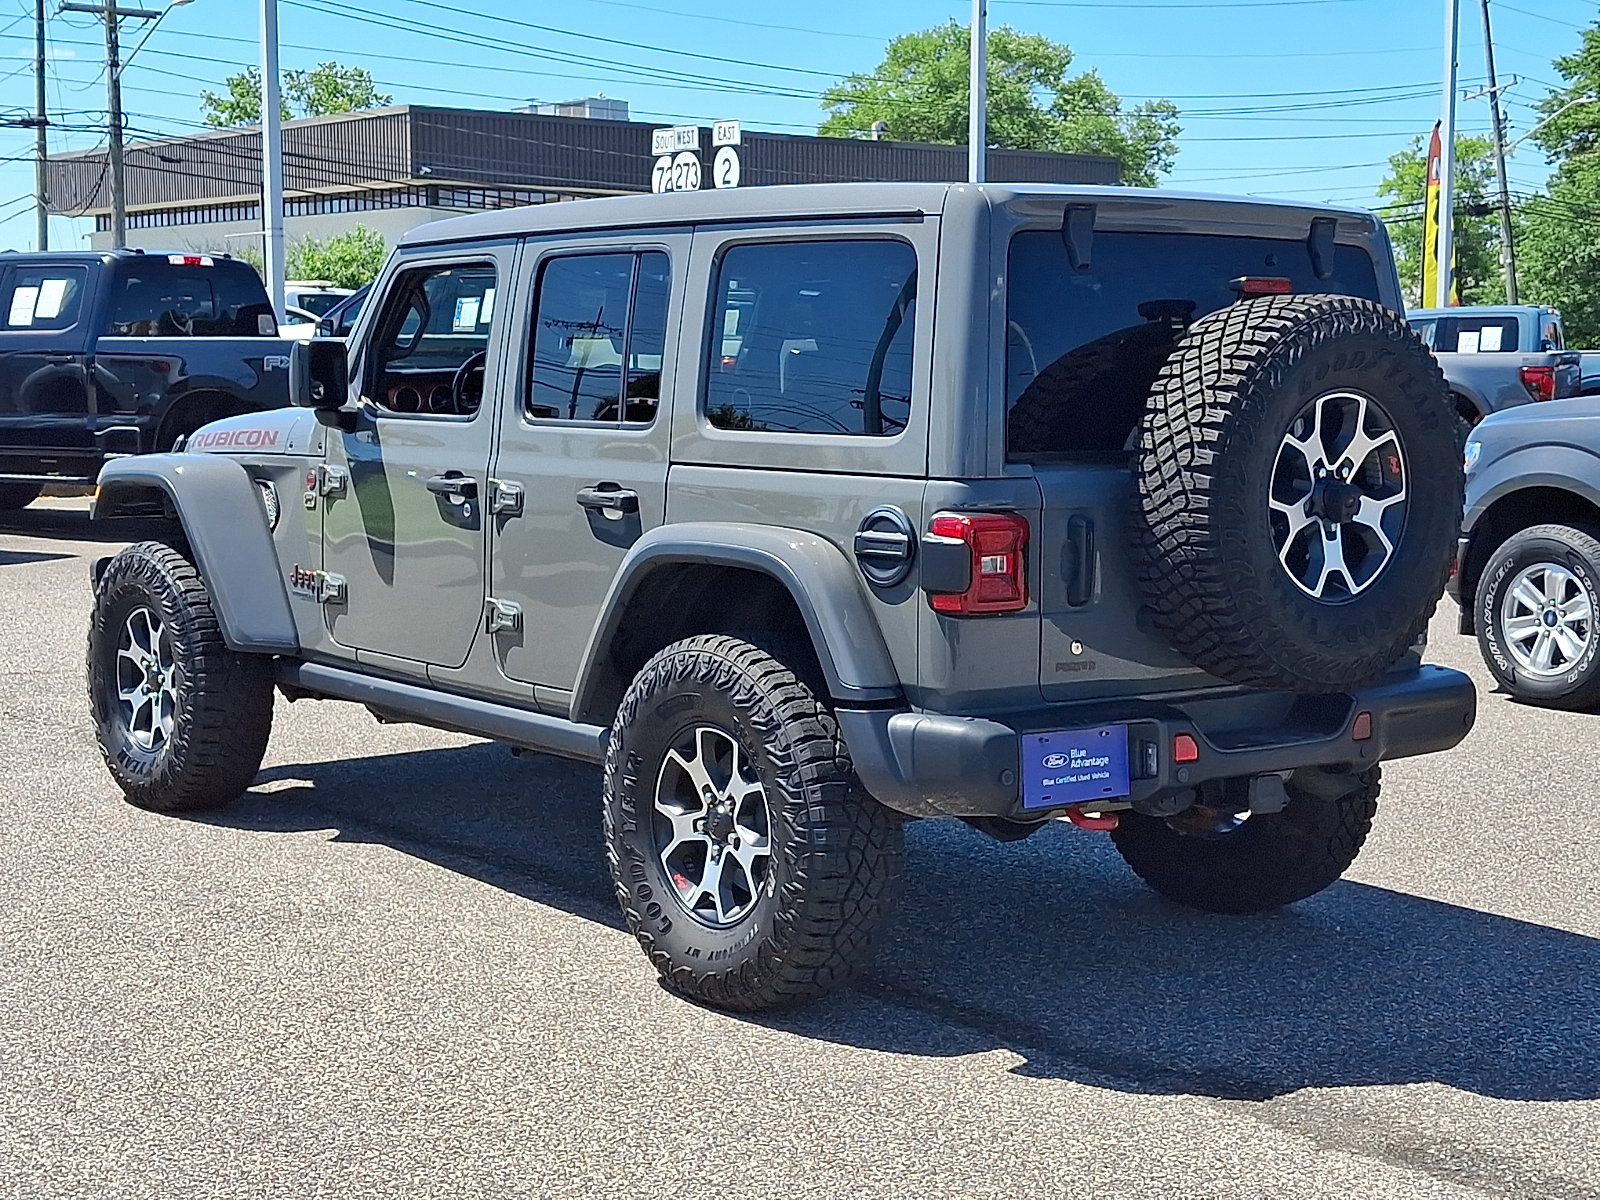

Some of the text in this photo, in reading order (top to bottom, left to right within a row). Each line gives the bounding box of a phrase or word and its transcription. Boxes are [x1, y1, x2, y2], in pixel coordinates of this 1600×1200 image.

[677, 129, 695, 145] WEST
[718, 125, 735, 141] EAST
[655, 135, 674, 149] SOUT
[675, 161, 698, 189] 273
[722, 157, 732, 185] 2
[656, 166, 673, 193] 72
[191, 429, 281, 448] RUBICON
[1484, 558, 1514, 671] WRANGLER
[1070, 748, 1087, 759] Blue
[1070, 756, 1110, 769] Advantage
[1055, 775, 1077, 785] Certified
[1091, 771, 1110, 780] Vehicle
